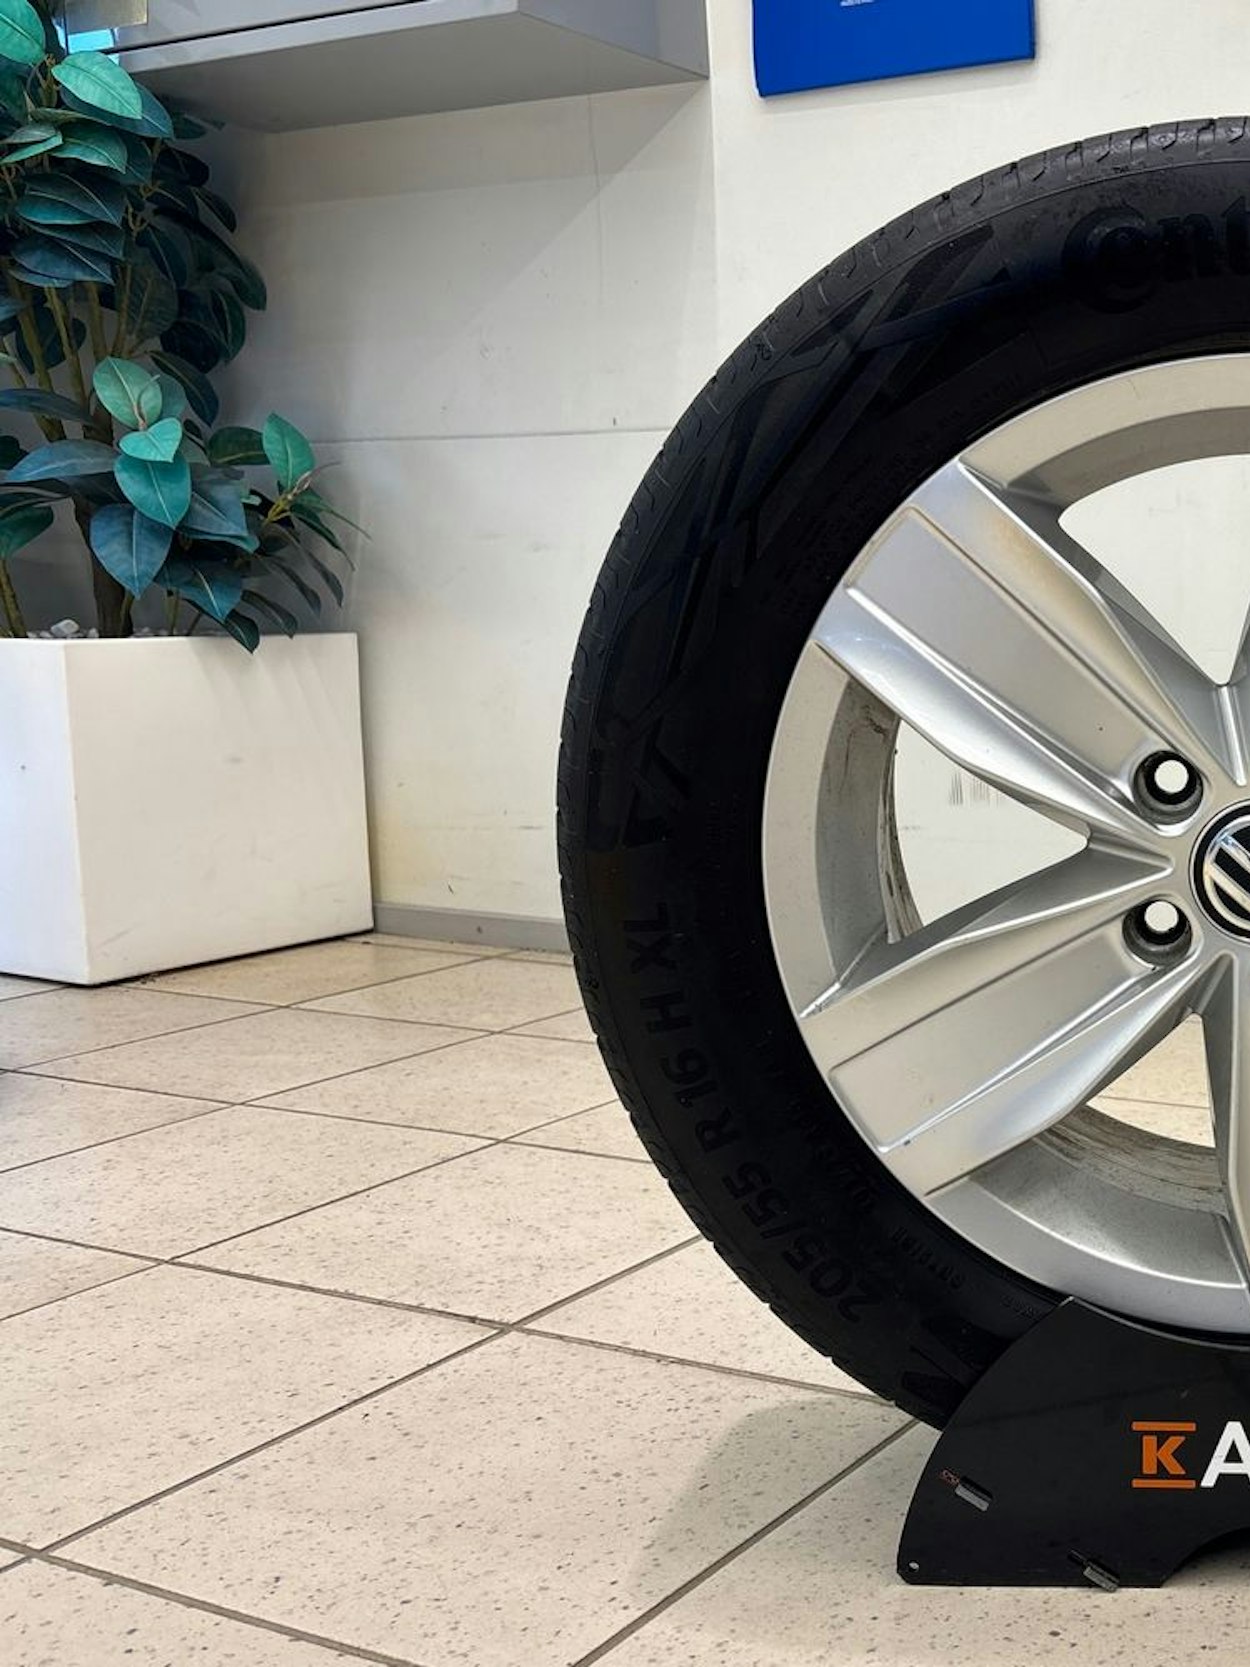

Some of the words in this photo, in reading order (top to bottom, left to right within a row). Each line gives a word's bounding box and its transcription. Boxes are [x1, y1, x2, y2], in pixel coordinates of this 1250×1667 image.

[624, 903, 676, 975] XL
[641, 993, 693, 1034] H
[662, 1048, 719, 1106] 16
[696, 1106, 740, 1153] R
[723, 1161, 878, 1323] 205/55
